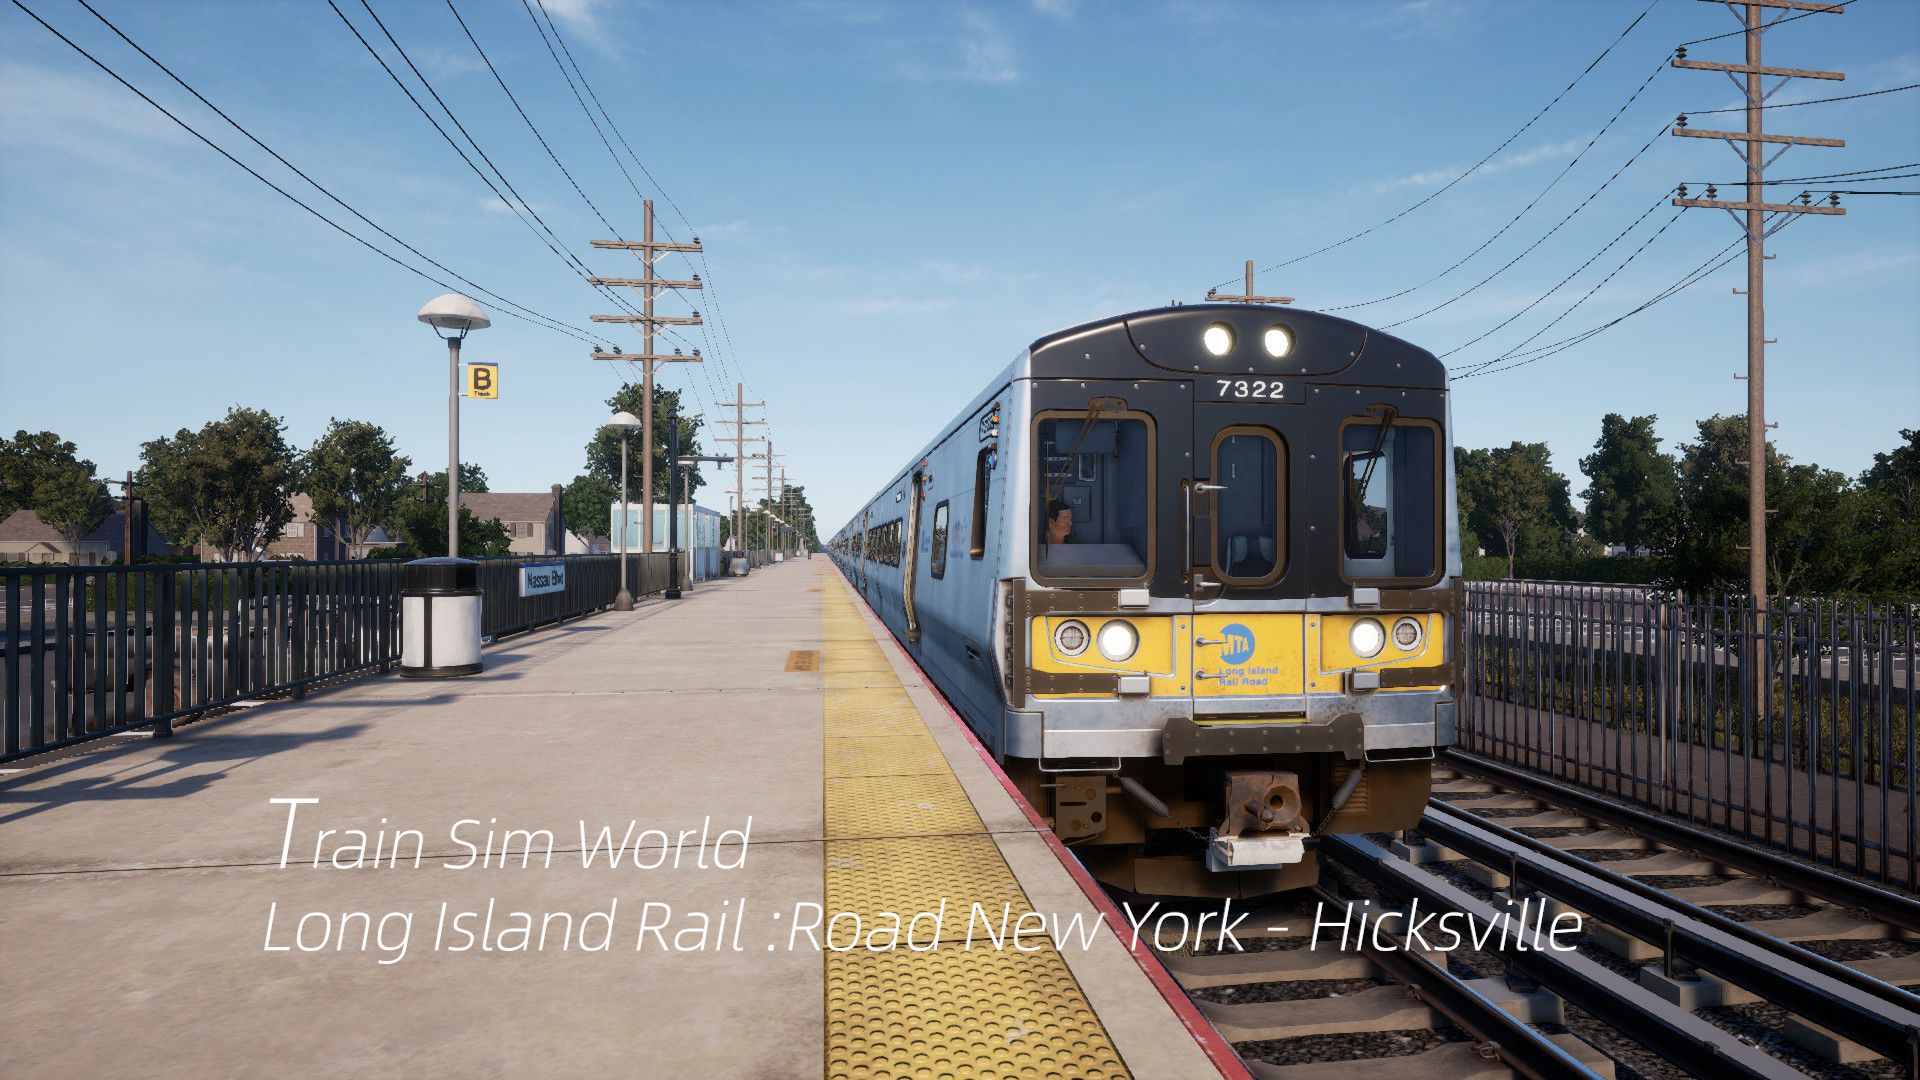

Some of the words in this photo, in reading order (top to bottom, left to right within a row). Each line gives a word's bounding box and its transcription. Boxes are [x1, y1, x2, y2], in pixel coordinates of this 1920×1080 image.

[473, 367, 492, 390] B
[1216, 379, 1284, 399] 7322
[527, 571, 551, 590] Nassau
[1219, 631, 1250, 656] MTA
[1218, 666, 1245, 676] Long
[1247, 665, 1279, 676] Island
[1218, 676, 1239, 687] Rail
[1242, 677, 1268, 686] Road
